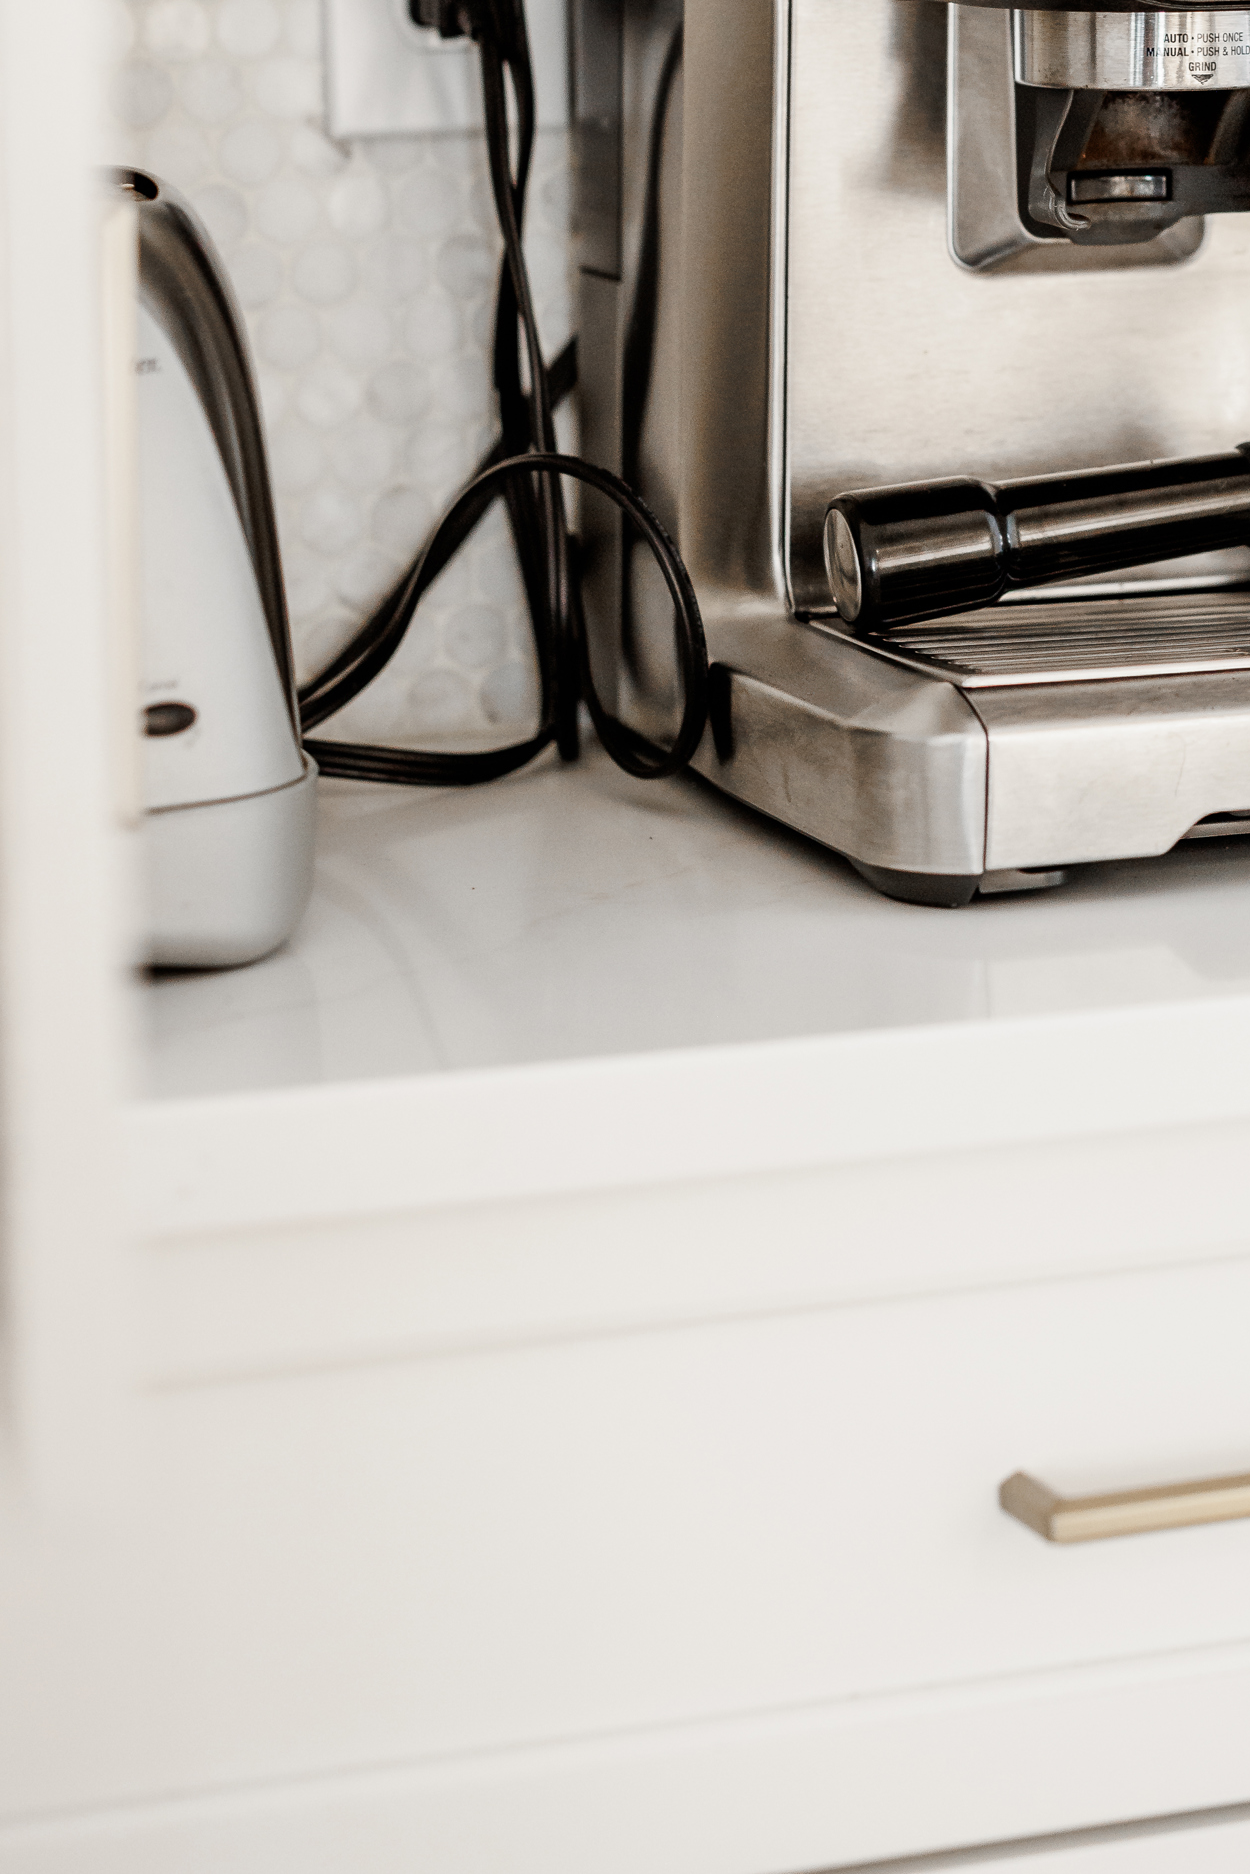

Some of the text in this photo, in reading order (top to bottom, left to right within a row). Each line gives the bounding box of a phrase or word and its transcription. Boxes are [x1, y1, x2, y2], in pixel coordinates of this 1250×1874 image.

[1163, 31, 1244, 43] AUTO PUSH ONCE
[1196, 46, 1220, 57] PUSH
[1222, 46, 1229, 56] &
[1230, 45, 1250, 56] HOLD
[1188, 61, 1217, 72] GRIND
